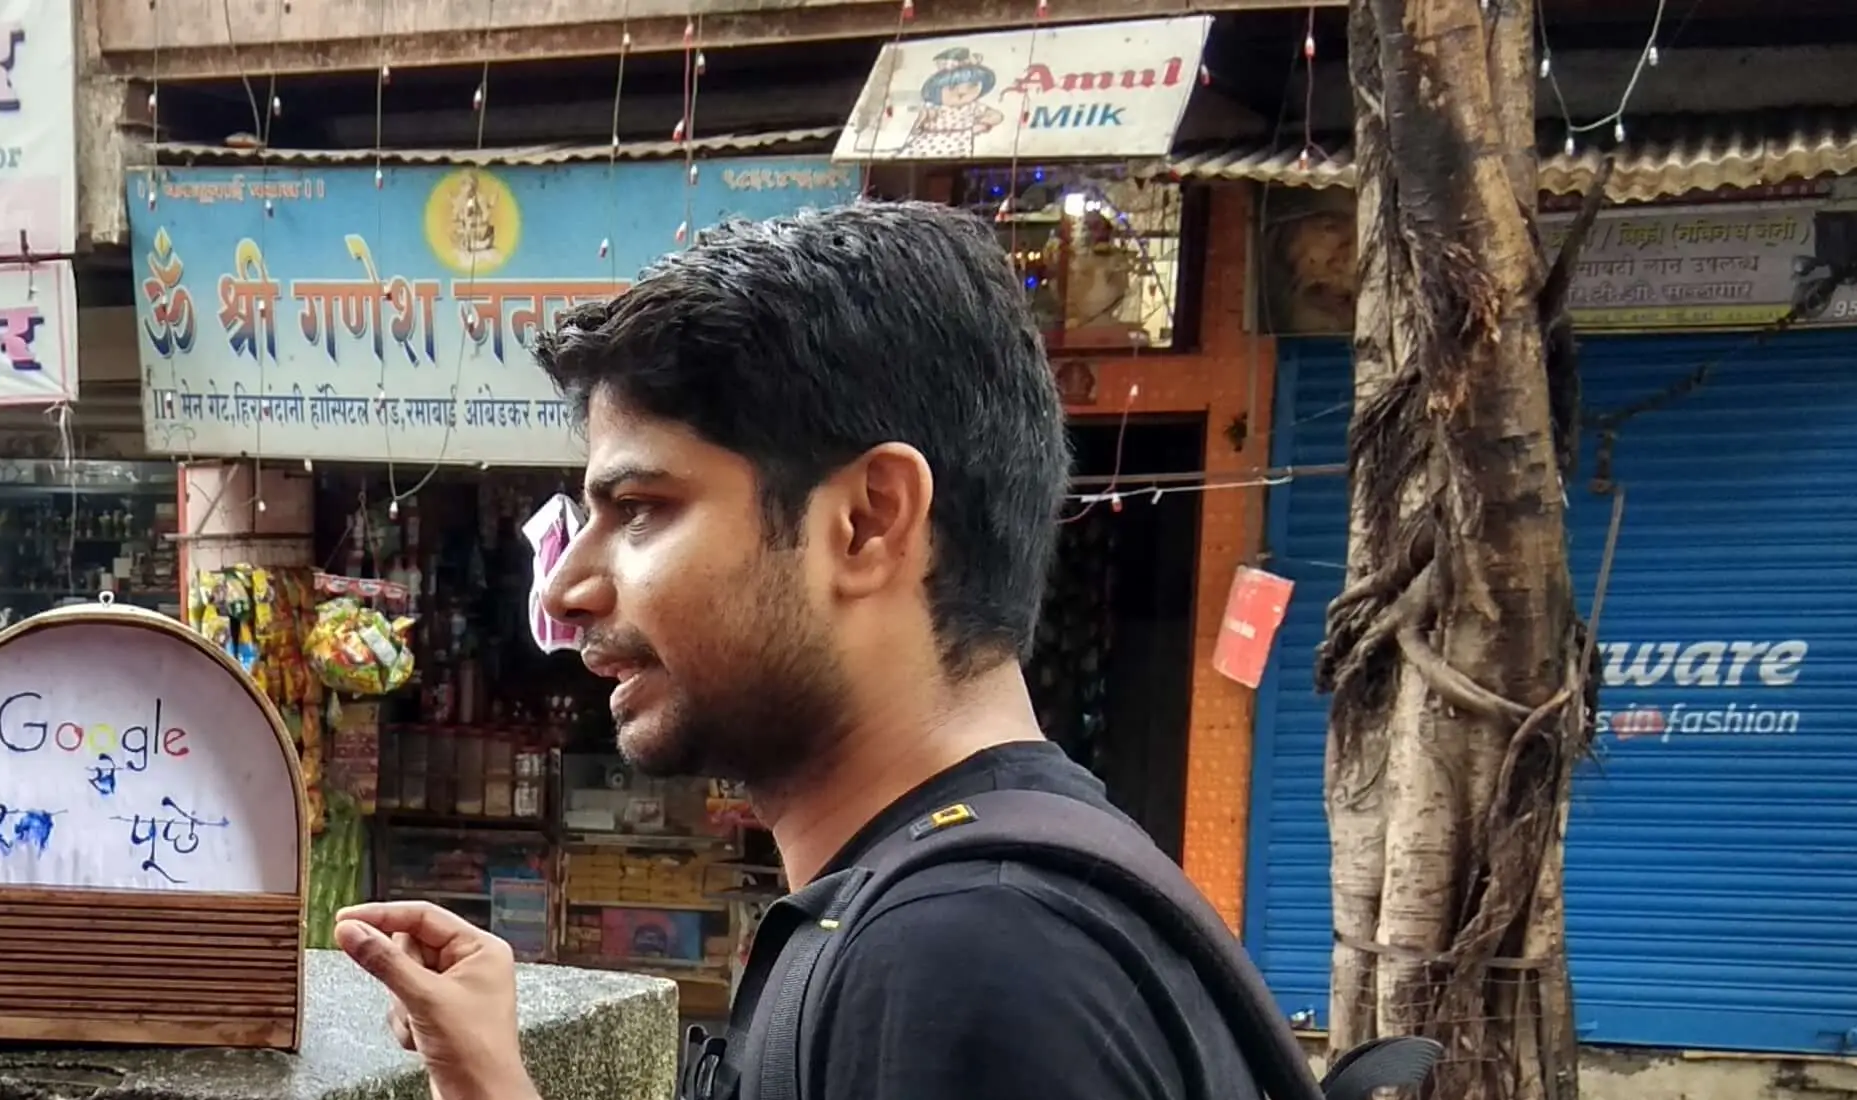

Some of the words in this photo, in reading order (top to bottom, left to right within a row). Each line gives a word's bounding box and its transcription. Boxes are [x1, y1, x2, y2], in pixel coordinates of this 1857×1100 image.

[1001, 57, 1183, 98] Amul
[1029, 103, 1128, 130] Milk
[218, 237, 282, 366] श्री
[291, 234, 441, 367] गणेश
[450, 277, 632, 366] जन
[181, 379, 203, 420] मेन
[1596, 639, 1809, 687] ware
[1623, 702, 1656, 733] in
[1660, 702, 1801, 743] fashion
